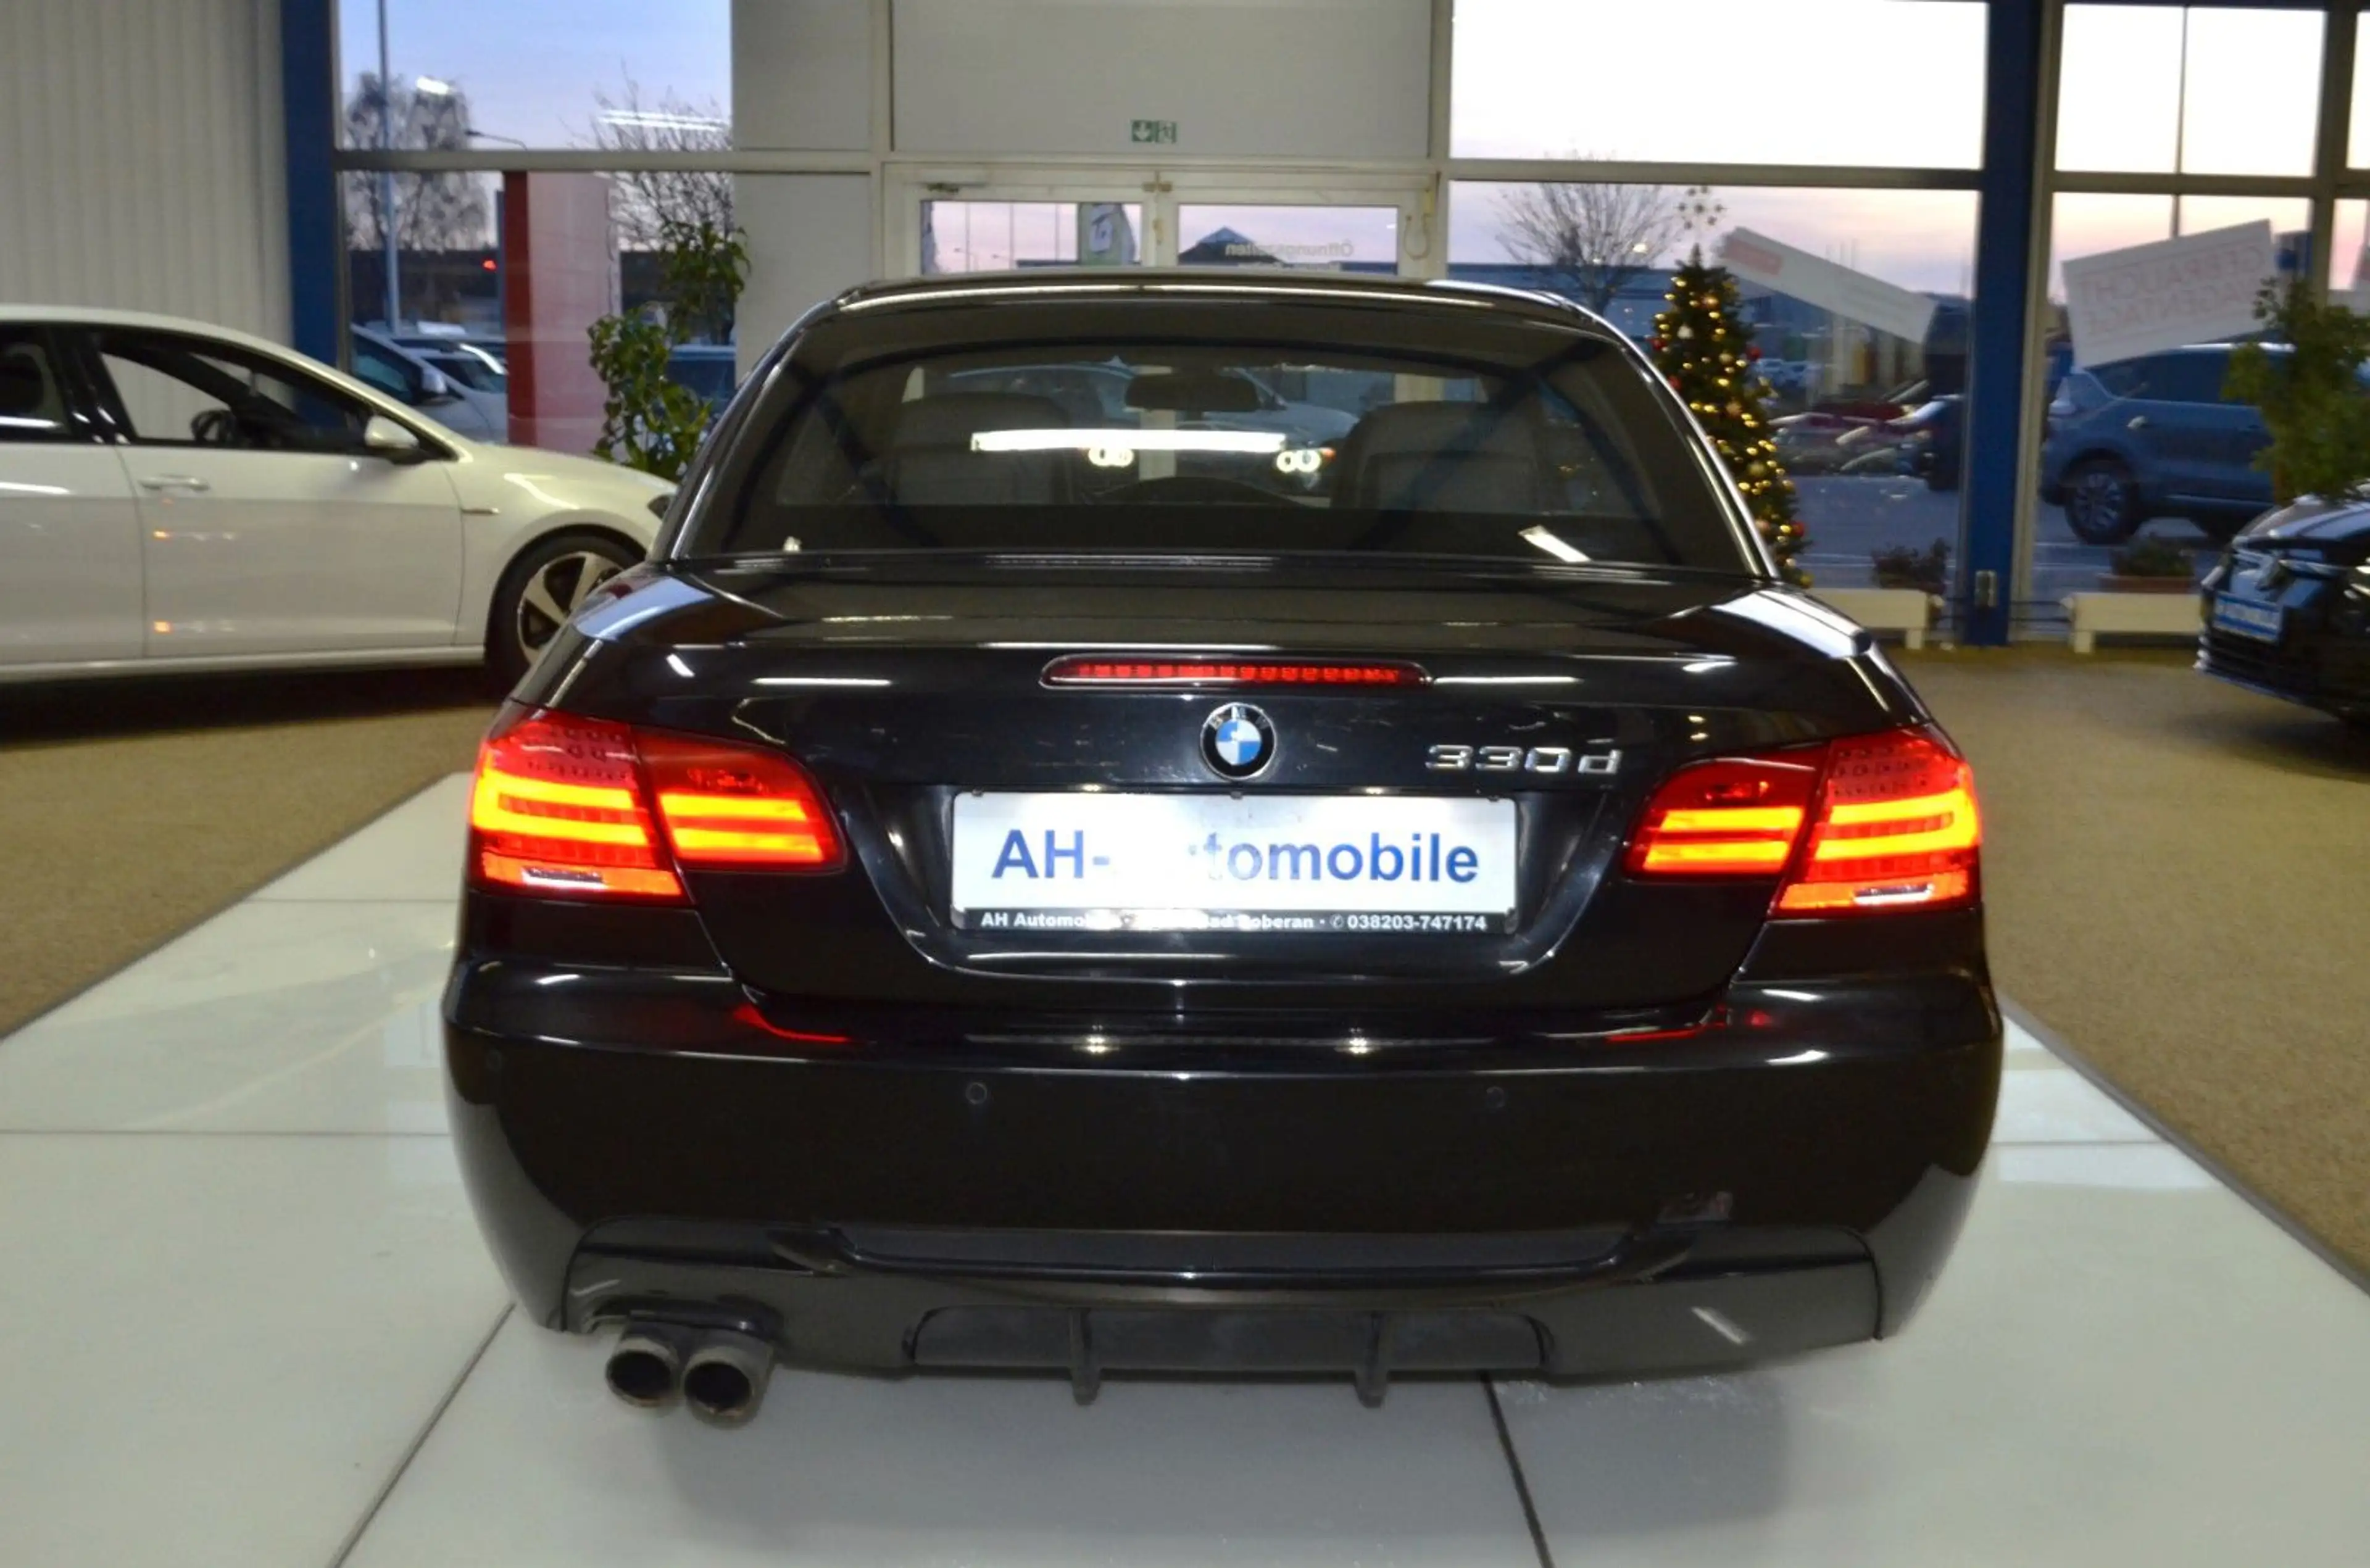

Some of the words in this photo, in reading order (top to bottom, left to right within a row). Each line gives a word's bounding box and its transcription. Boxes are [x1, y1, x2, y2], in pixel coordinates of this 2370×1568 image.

[991, 829, 1479, 884] AH-tomobile
[981, 912, 1008, 926] AH
[1013, 912, 1116, 927] Automo
[1347, 915, 1487, 931] 038203-747174
